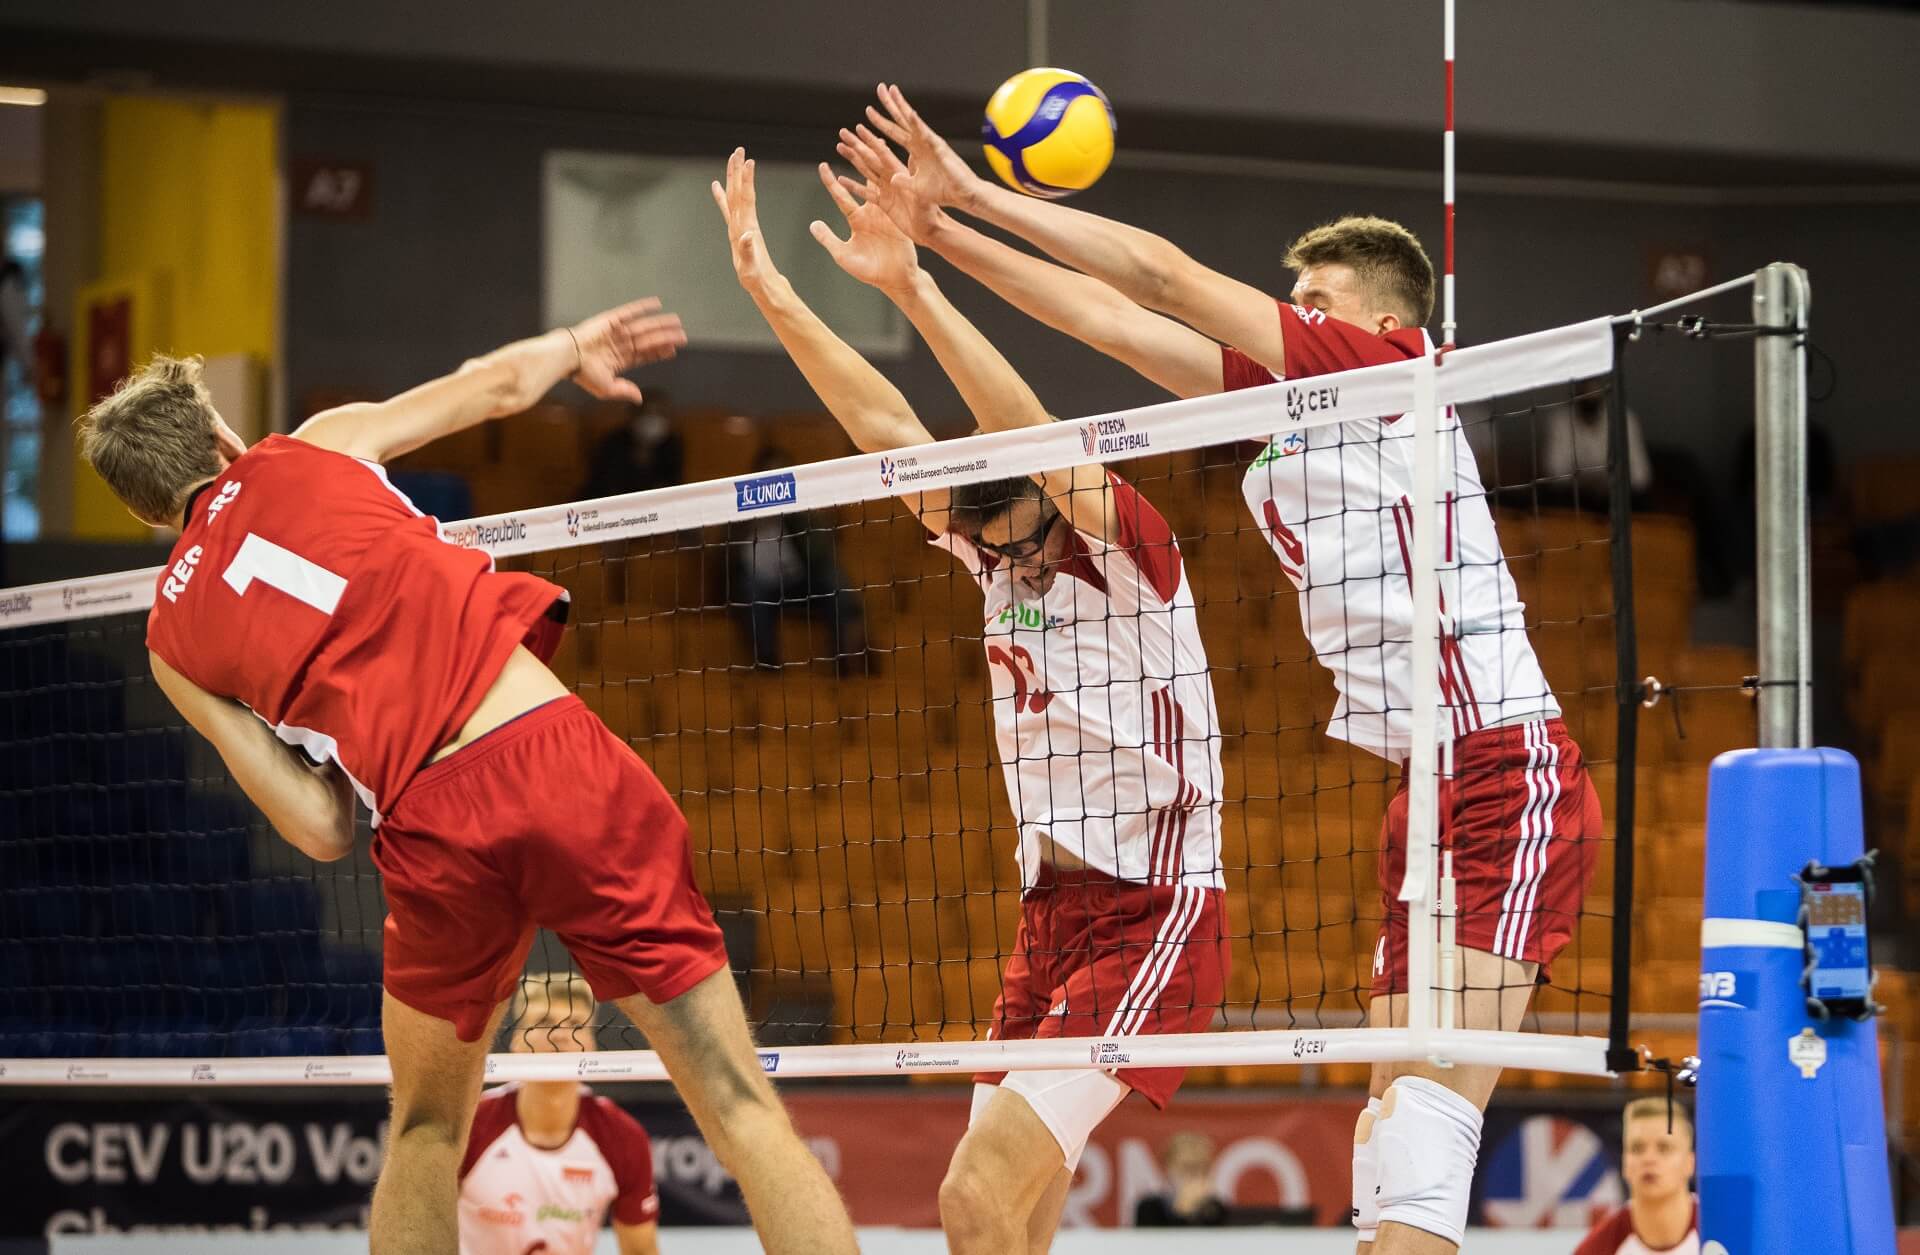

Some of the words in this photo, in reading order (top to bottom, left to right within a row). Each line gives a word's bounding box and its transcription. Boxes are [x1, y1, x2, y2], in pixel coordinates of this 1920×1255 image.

[1308, 387, 1339, 411] CEV
[1097, 417, 1126, 436] CZECH
[1099, 431, 1150, 454] VOLLEYBALL
[898, 470, 920, 482] Volleyball
[920, 468, 942, 479] European
[942, 462, 975, 475] Championship
[975, 459, 988, 470] 2020
[757, 481, 791, 503] UNIQA
[222, 531, 348, 616] 1
[1101, 1043, 1119, 1053] CZECH
[1306, 1040, 1327, 1053] CEV
[1099, 1053, 1130, 1064] VOLLEYBALL
[45, 1123, 169, 1183] CEV
[180, 1123, 296, 1183] U20
